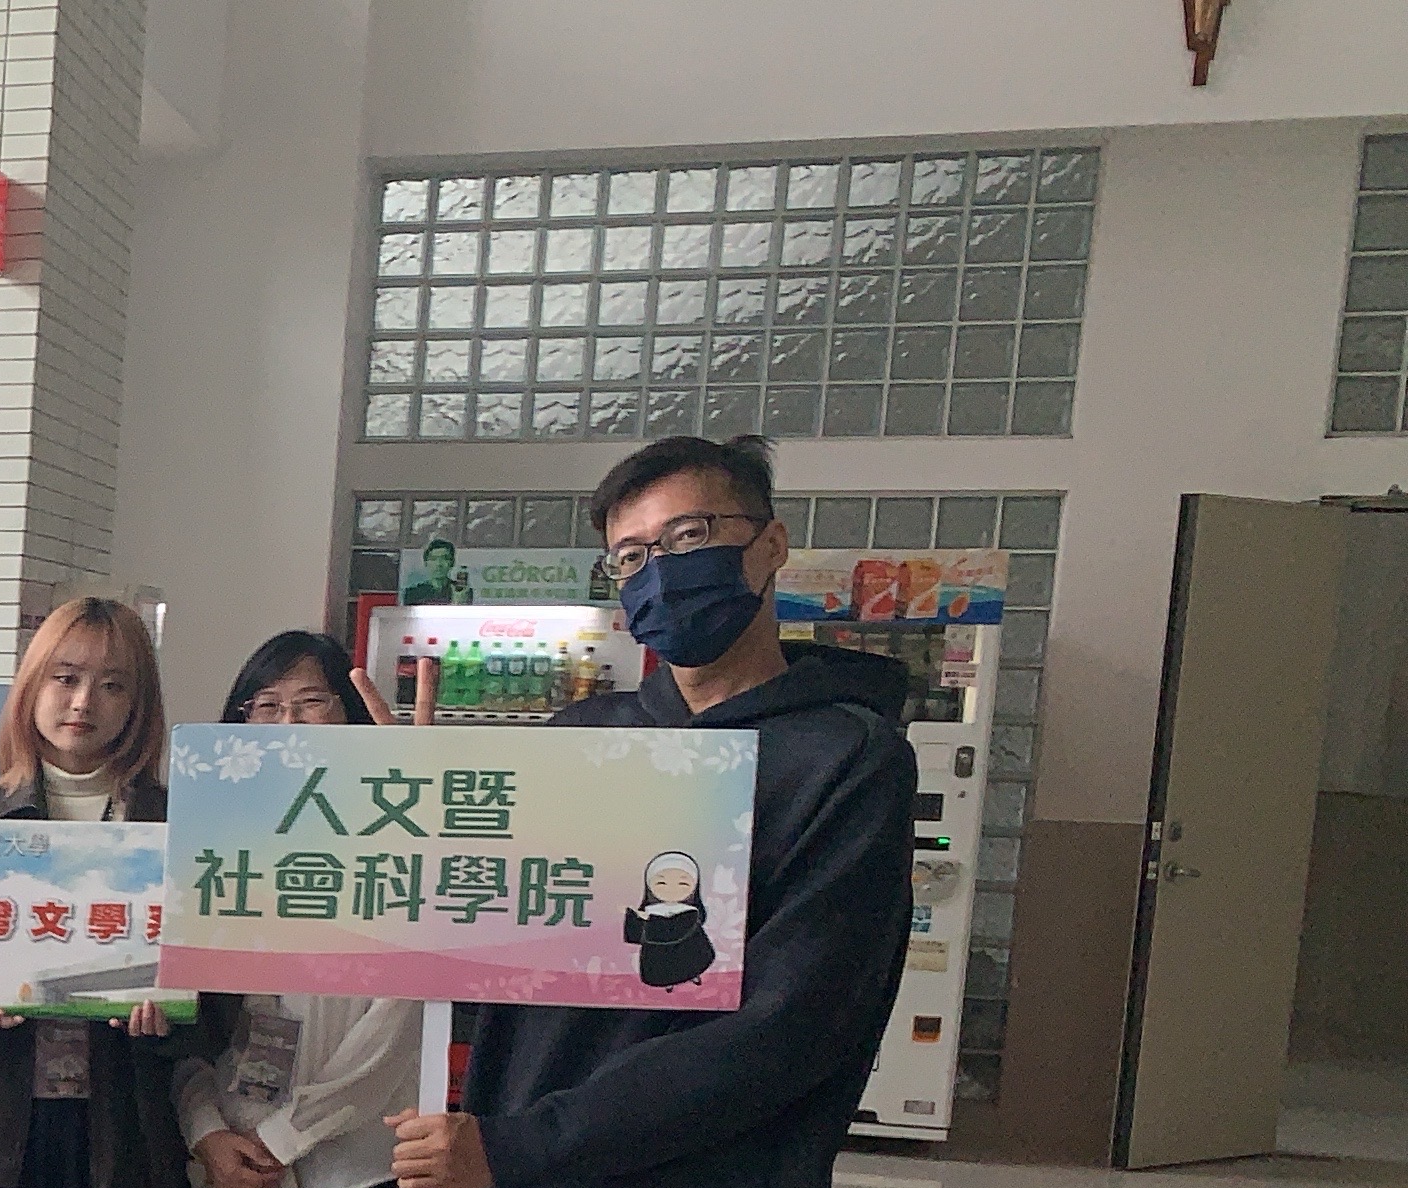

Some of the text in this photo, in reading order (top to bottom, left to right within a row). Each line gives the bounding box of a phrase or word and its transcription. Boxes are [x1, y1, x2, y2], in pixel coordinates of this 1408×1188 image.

[274, 766, 516, 840] 人文暨
[192, 848, 595, 928] 社會科學院
